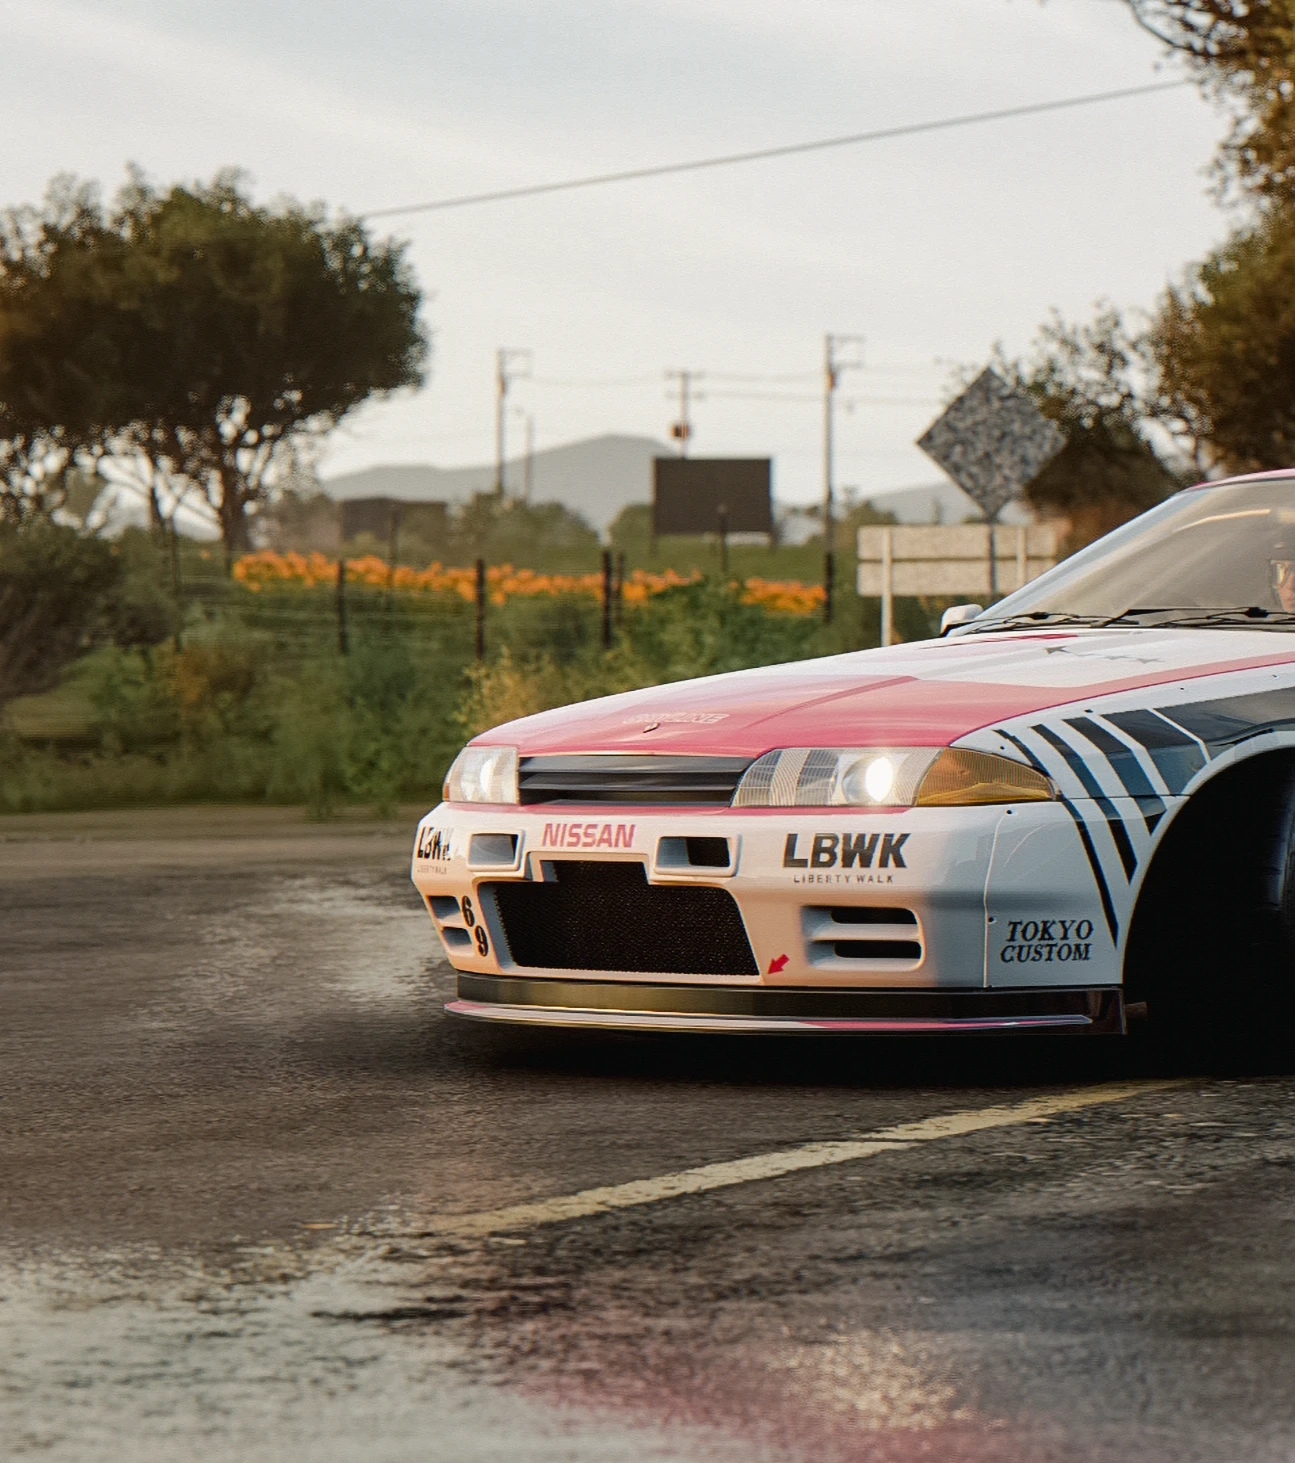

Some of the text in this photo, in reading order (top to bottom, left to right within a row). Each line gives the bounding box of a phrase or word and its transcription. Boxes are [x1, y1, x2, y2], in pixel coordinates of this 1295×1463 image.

[542, 823, 636, 848] NISSAN
[783, 832, 911, 868] LBWK
[793, 874, 894, 883] LIBERTY WALK
[1006, 919, 1094, 942] TOKYO
[1000, 943, 1092, 963] CUSTOM
